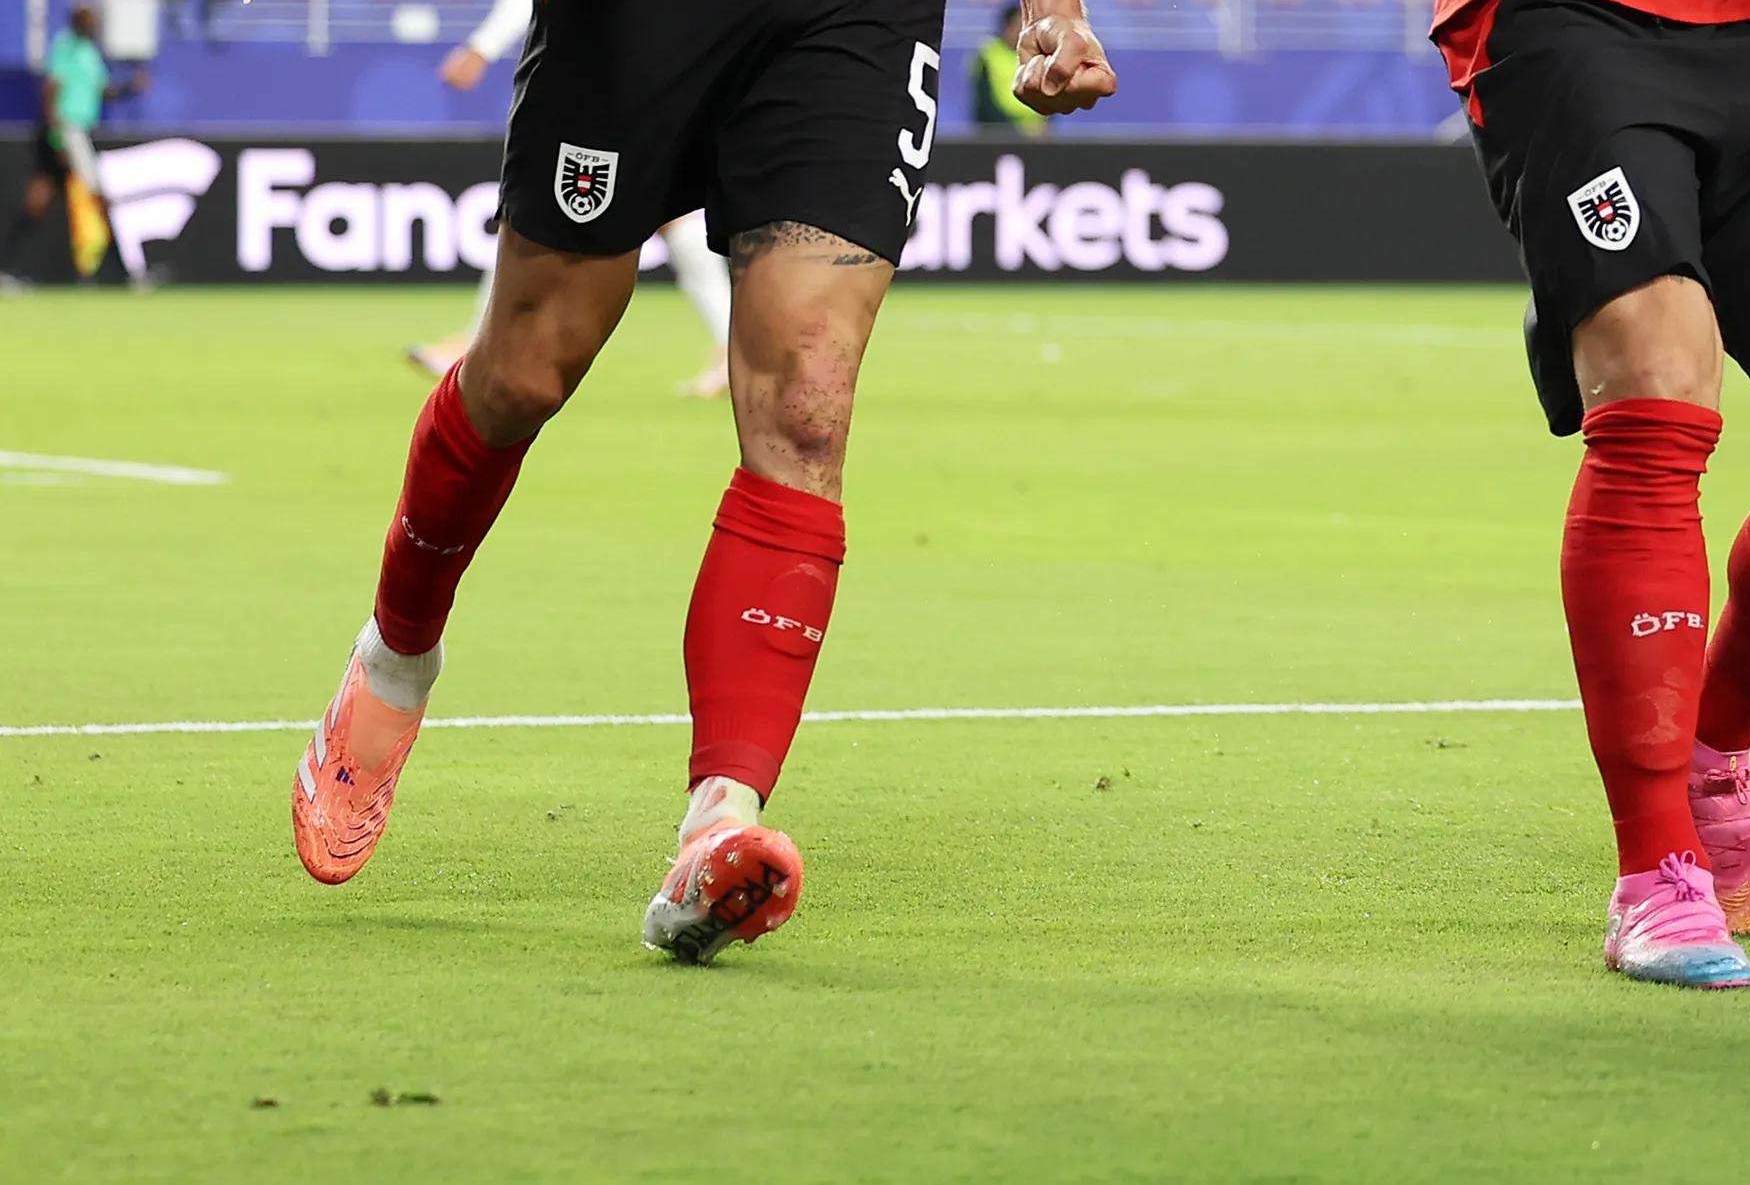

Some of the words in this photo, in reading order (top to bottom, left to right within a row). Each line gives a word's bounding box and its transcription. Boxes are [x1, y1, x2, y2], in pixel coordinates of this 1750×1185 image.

[898, 41, 940, 170] 5
[898, 154, 1229, 272] arkets
[741, 607, 822, 642] ÖFB
[1631, 611, 1704, 637] ÖFB
